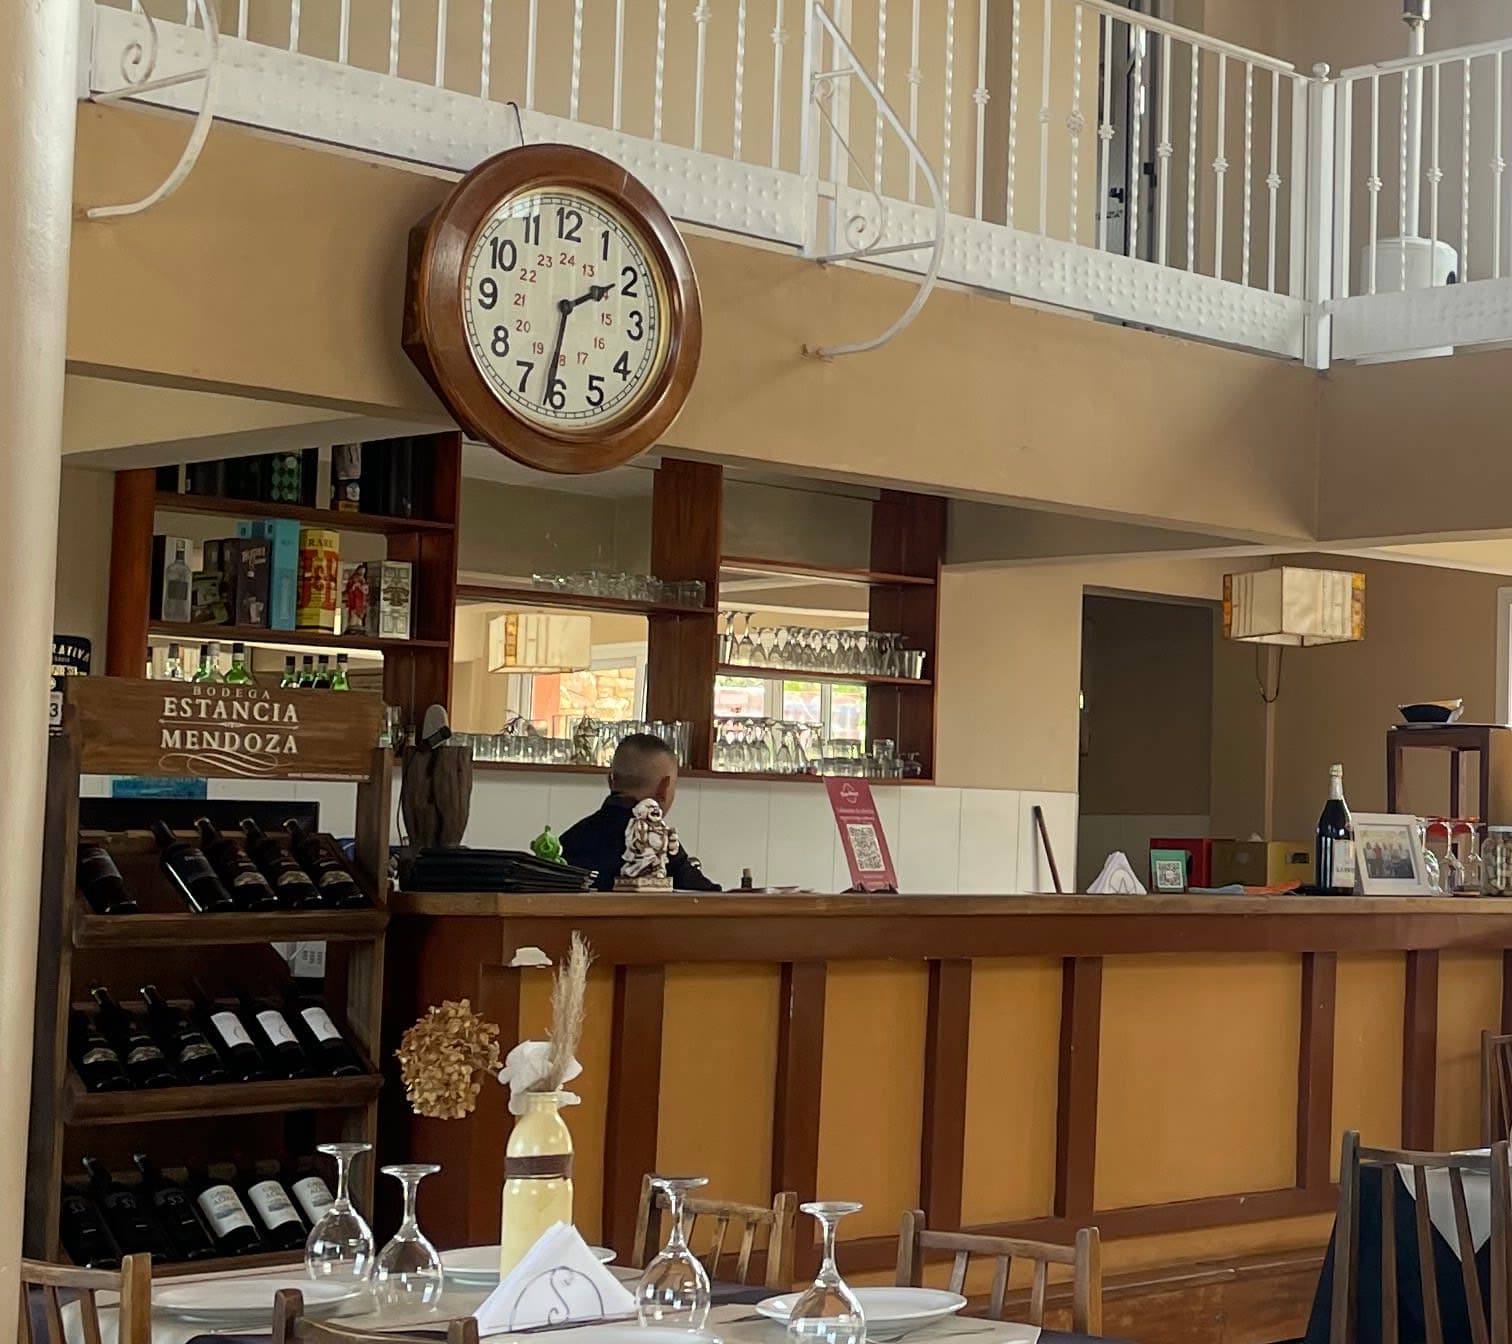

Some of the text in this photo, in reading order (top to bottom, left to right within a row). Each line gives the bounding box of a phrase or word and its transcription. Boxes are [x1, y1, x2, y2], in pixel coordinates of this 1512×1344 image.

[523, 214, 540, 246] 11
[557, 208, 583, 242] 12
[490, 237, 517, 271] 10
[601, 231, 610, 260] 1
[537, 255, 552, 267] 23
[560, 253, 575, 265] 24
[582, 264, 595, 277] 13
[520, 269, 536, 283] 22
[621, 267, 638, 297] 2
[479, 278, 498, 309] 9
[514, 294, 525, 306] 21
[516, 320, 530, 332] 20
[601, 314, 612, 326] 15
[627, 311, 643, 341] 3
[492, 326, 509, 357] 8
[532, 342, 544, 354] 19
[593, 337, 605, 349] 16
[577, 353, 588, 364] 17
[613, 351, 631, 380] 4
[517, 361, 534, 392] 7
[549, 380, 566, 409] 6
[586, 375, 604, 406] 5
[193, 686, 271, 699] BODEGA
[163, 697, 299, 723] ESTANCIA
[160, 730, 298, 753] MENDOZA
